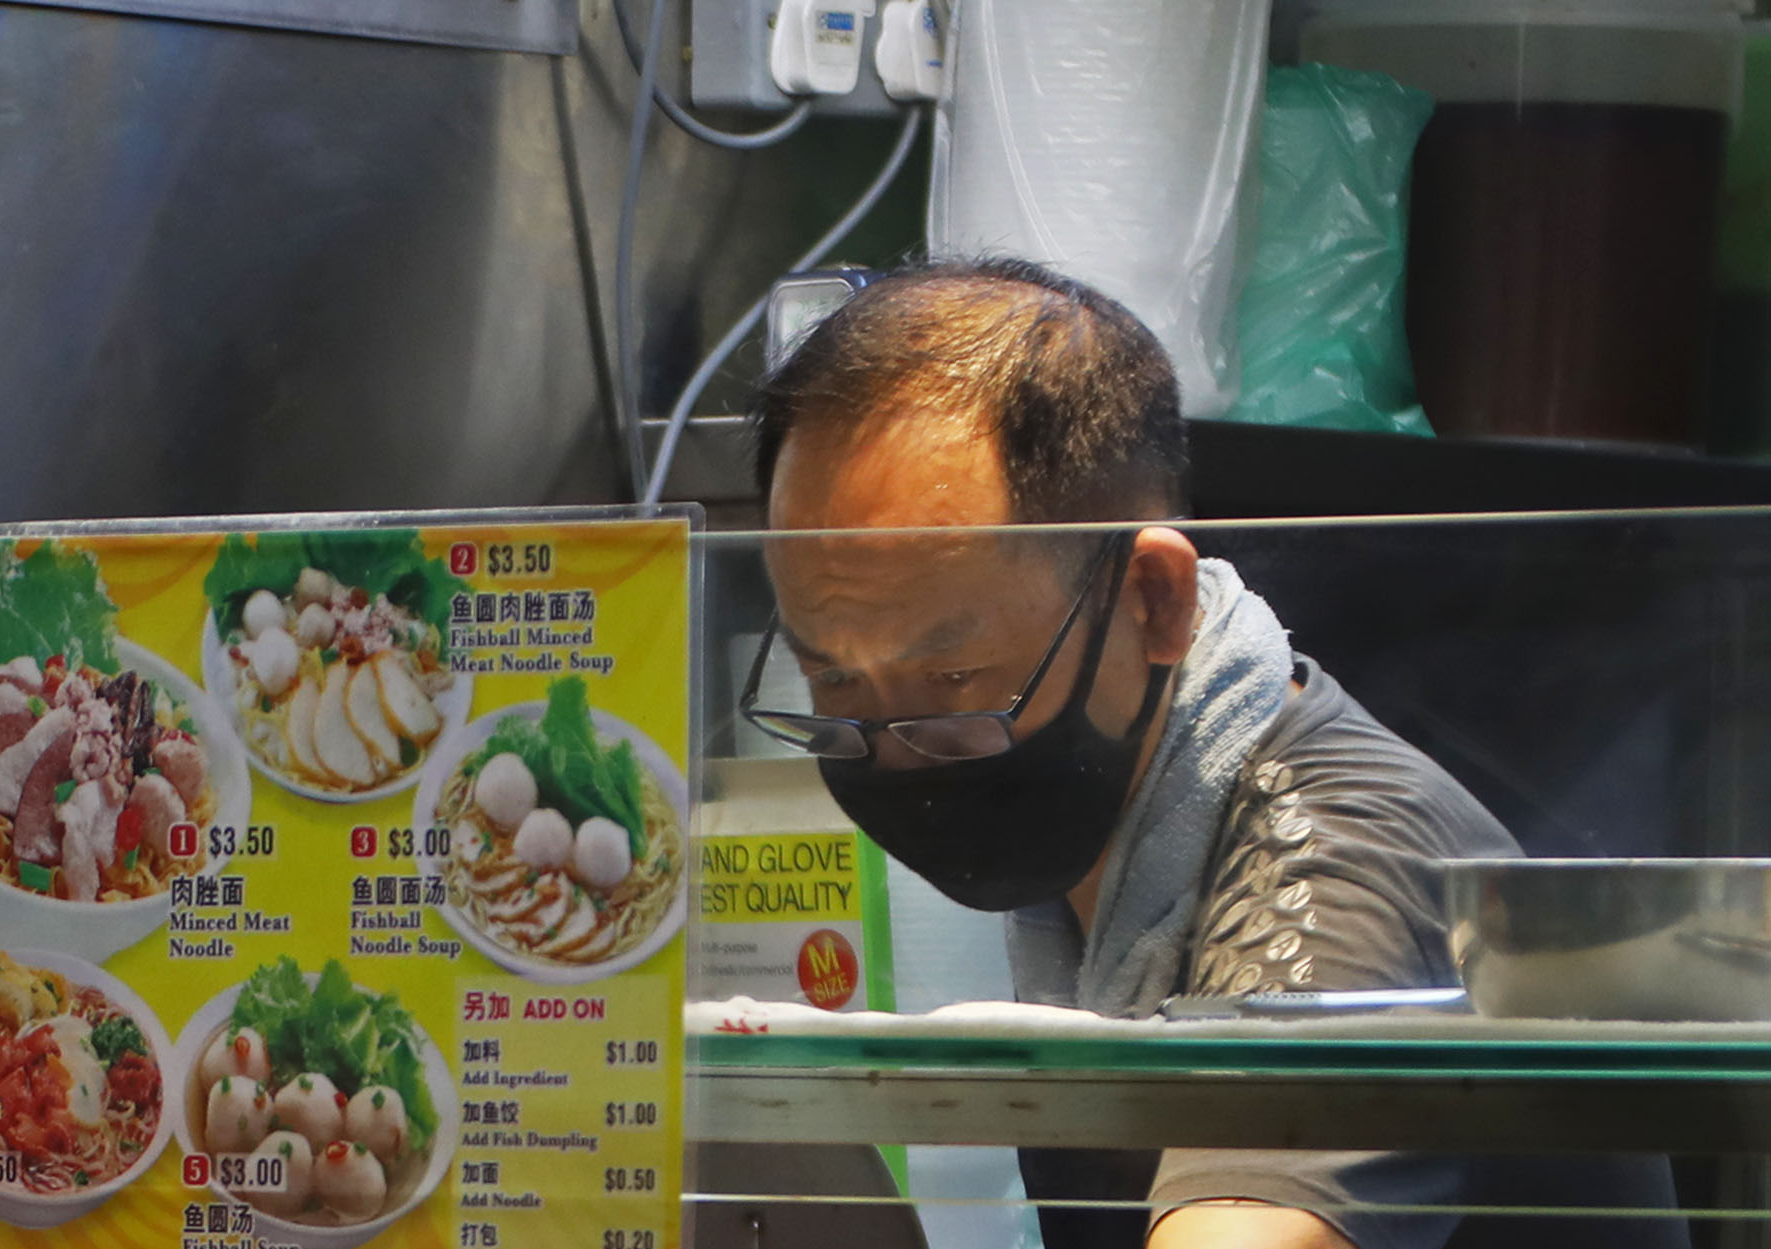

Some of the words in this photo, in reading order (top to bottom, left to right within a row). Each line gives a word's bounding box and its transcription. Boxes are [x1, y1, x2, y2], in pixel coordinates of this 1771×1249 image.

[488, 544, 551, 577] $3.50
[450, 628, 520, 648] Fishball
[527, 626, 593, 646] Minced
[450, 655, 494, 673] Meat
[500, 653, 562, 672] Noodle
[569, 652, 614, 675] Soup
[209, 825, 274, 860] $3.50
[388, 827, 451, 860] $3.00
[702, 845, 750, 874] AND
[758, 841, 853, 874] GLOVE
[351, 875, 446, 906] 鱼圆面汤
[701, 883, 741, 913] EST
[745, 881, 853, 912] QUALITY
[169, 912, 237, 931] Minced
[243, 912, 290, 931] Meat
[351, 911, 421, 929] Fishball
[169, 938, 234, 957] Noodle
[350, 935, 412, 954] Noodle
[418, 935, 462, 959] Soup
[807, 934, 840, 978] M
[814, 975, 851, 1003] SIZE
[463, 991, 510, 1021] 另加
[523, 998, 567, 1019] ADD
[573, 998, 605, 1019] ON
[463, 1040, 500, 1063] 加料
[606, 1040, 658, 1064] $1.00
[462, 1072, 489, 1085] Add
[494, 1071, 568, 1089] Ingredient
[463, 1101, 519, 1124] 加鱼饺
[605, 1102, 656, 1126] $1.00
[462, 1133, 489, 1146] Add
[493, 1132, 522, 1146] Fish
[528, 1133, 598, 1150] Dumpling
[220, 1157, 282, 1188] $3.00
[462, 1162, 499, 1185] 加面
[605, 1168, 655, 1192] $0.50
[461, 1194, 488, 1207] Add
[492, 1193, 541, 1208] Noodle
[183, 1204, 253, 1234] 鱼圆汤
[461, 1223, 497, 1247] 打包
